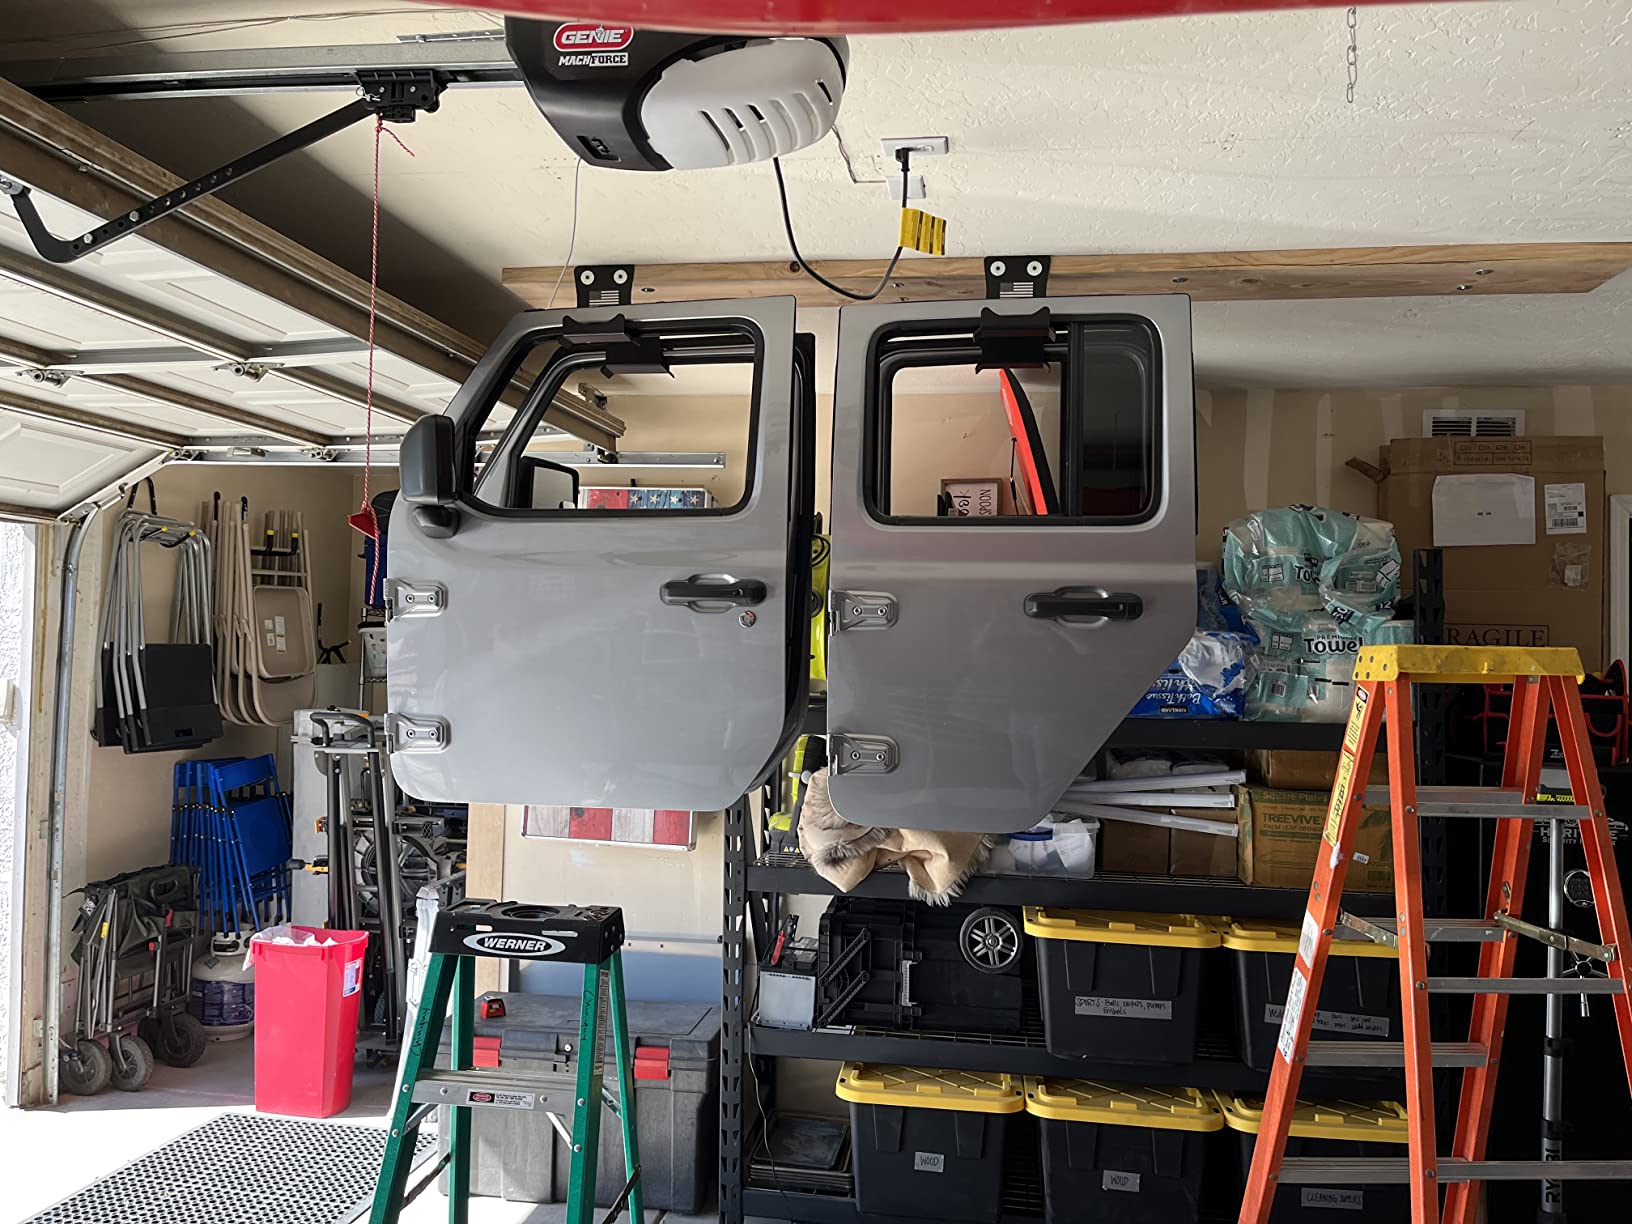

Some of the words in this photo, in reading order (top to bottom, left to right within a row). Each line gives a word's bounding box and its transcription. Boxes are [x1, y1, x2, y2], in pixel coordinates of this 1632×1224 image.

[561, 29, 625, 44] GENIE
[1445, 627, 1546, 647] RAGILE
[1263, 791, 1297, 802] Square
[1263, 813, 1321, 825] TREEVIVE
[484, 937, 547, 951] WERNER
[920, 1155, 939, 1167] WOOD
[1110, 1175, 1129, 1185] WOOD
[1545, 1148, 1560, 1203] RYBI
